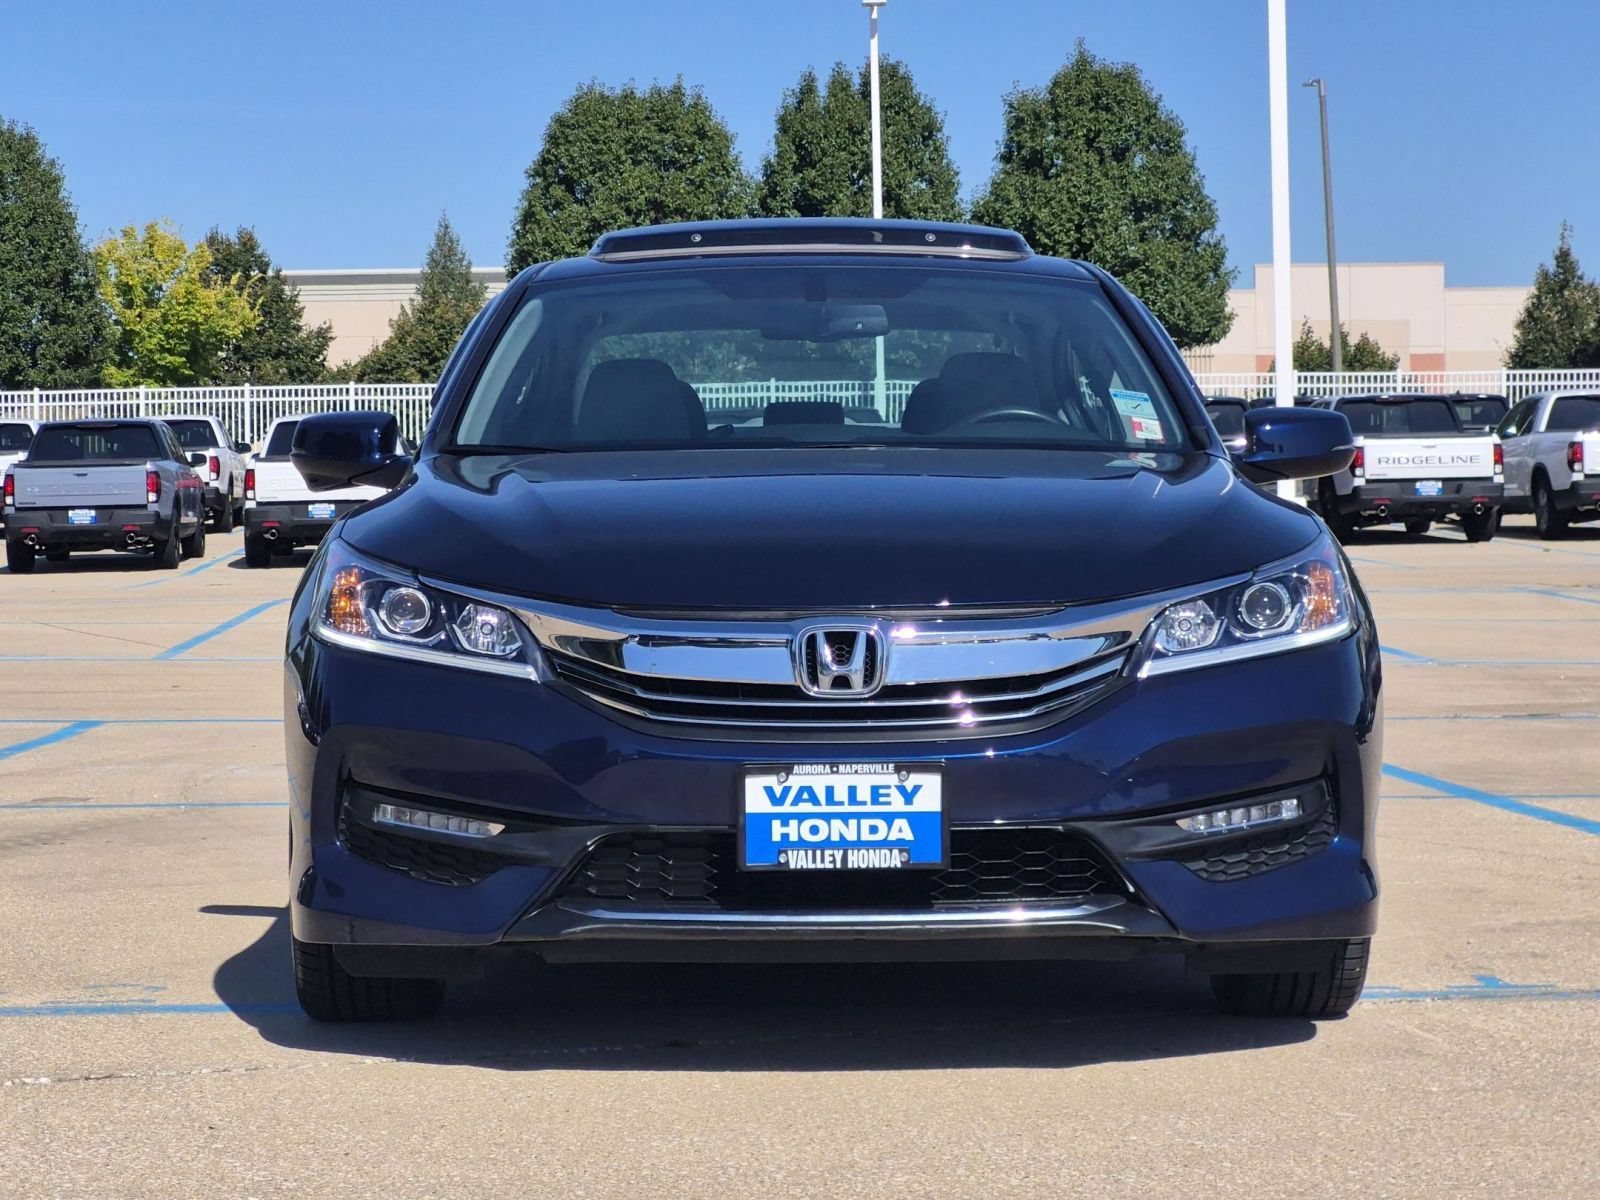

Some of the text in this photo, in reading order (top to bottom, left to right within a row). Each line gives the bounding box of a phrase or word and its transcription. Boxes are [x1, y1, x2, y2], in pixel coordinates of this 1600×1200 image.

[1378, 455, 1481, 465] RIDGELINE
[793, 763, 895, 775] AURORA NAPERVILLE
[763, 784, 923, 807] VALLEY
[771, 818, 915, 842] HONDA
[787, 848, 902, 869] VALLEY HONDA
